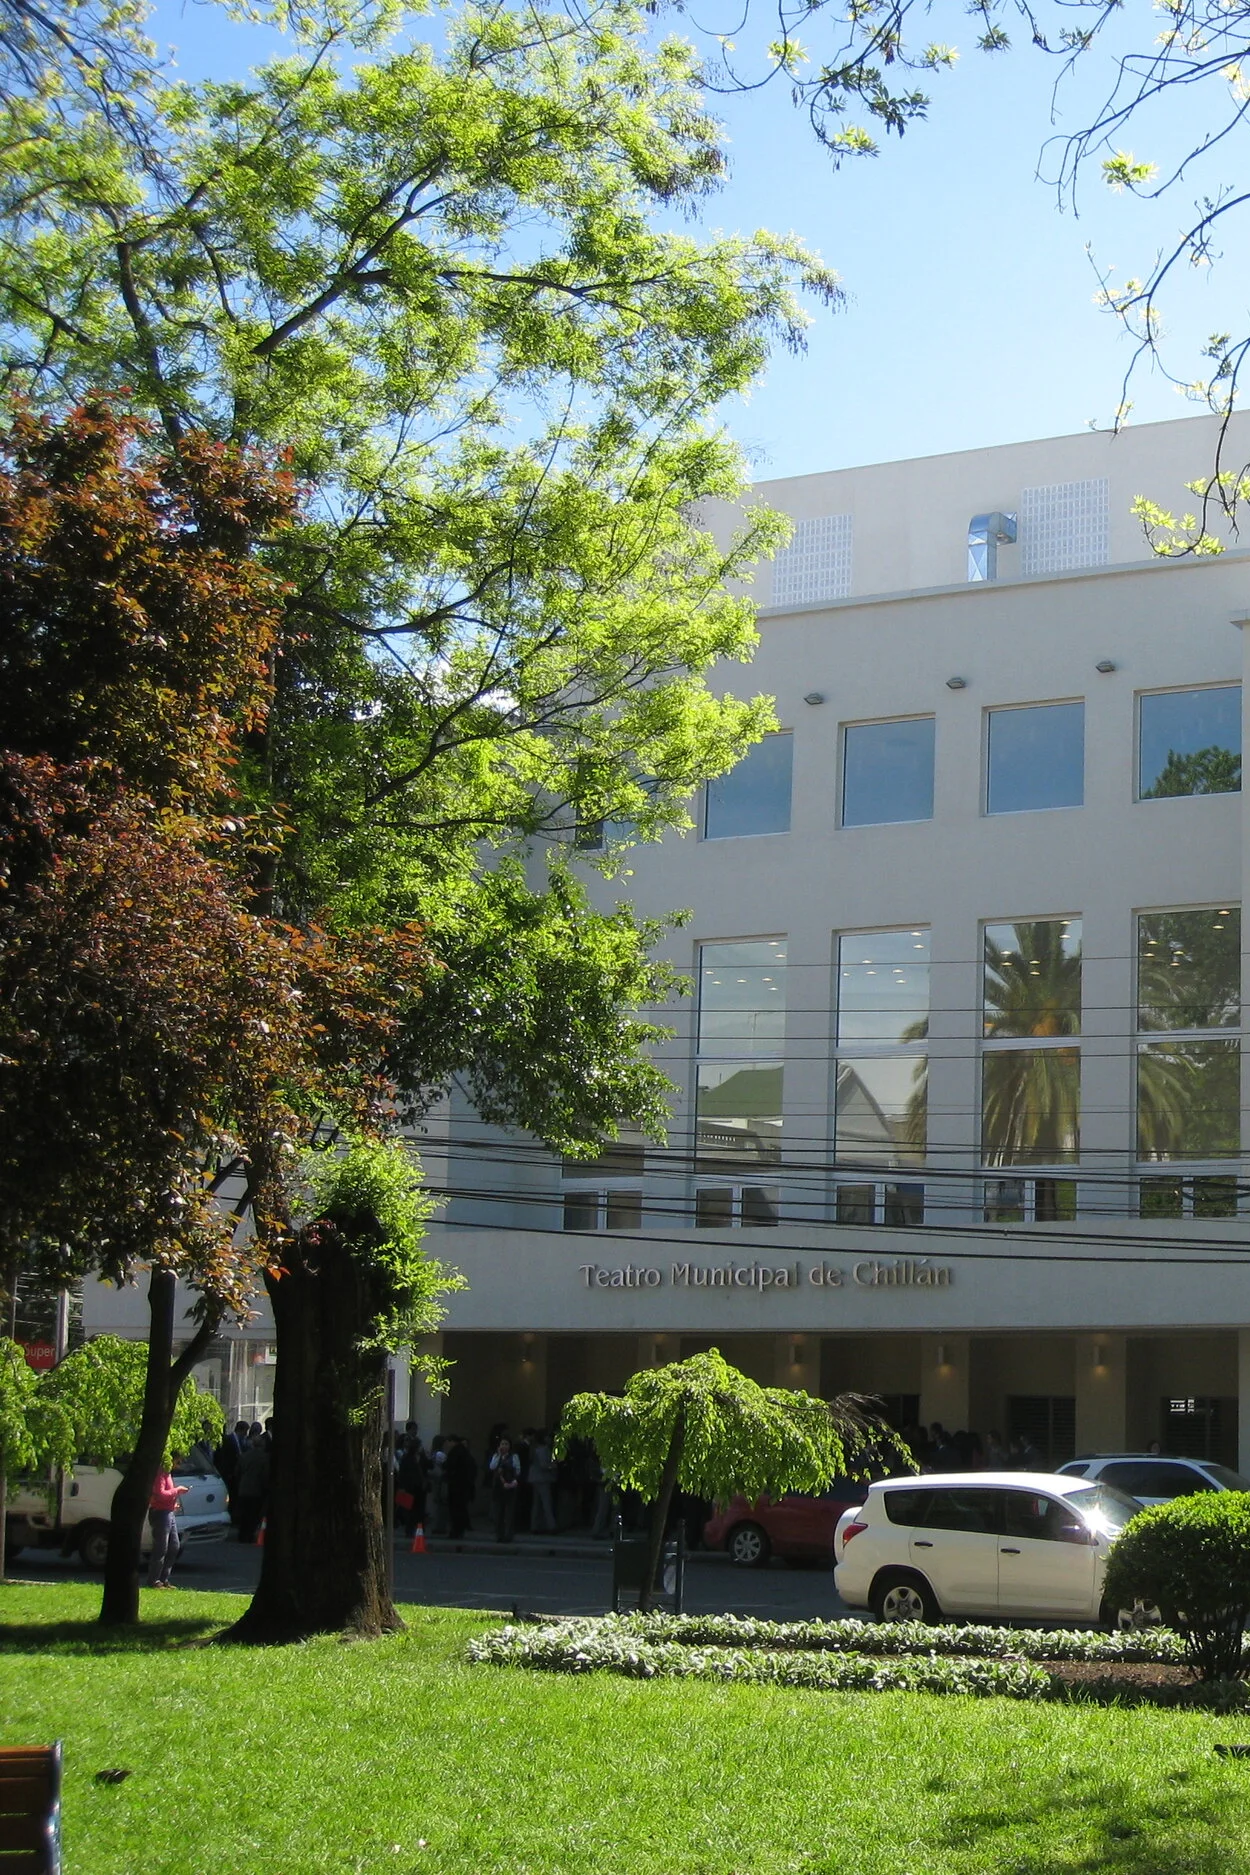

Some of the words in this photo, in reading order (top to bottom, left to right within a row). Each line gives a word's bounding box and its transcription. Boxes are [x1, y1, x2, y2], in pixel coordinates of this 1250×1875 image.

[579, 1263, 661, 1288] Teatro
[671, 1261, 799, 1292] Municipal
[808, 1260, 842, 1287] de
[852, 1259, 952, 1287] Chillán
